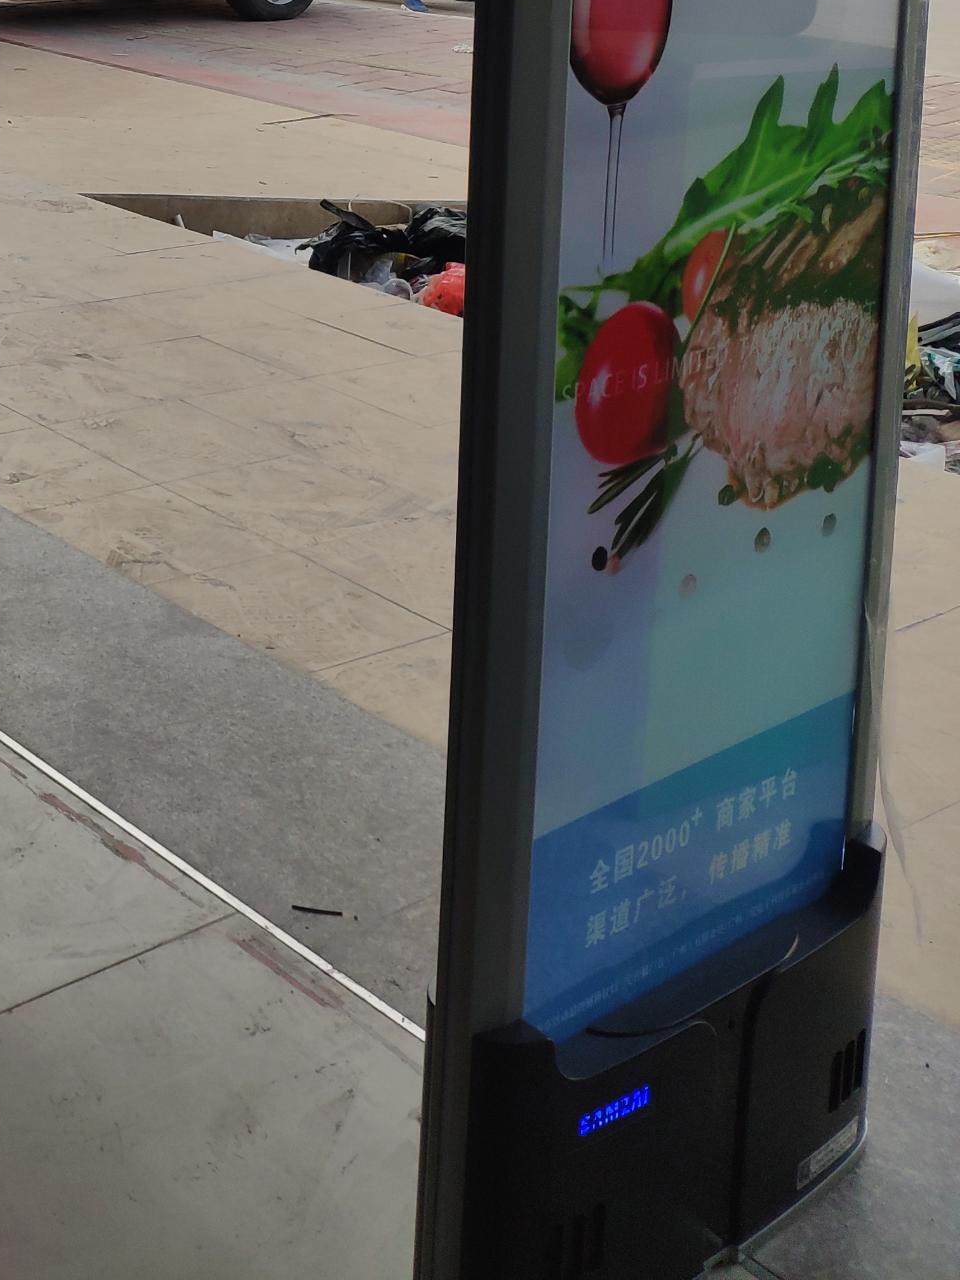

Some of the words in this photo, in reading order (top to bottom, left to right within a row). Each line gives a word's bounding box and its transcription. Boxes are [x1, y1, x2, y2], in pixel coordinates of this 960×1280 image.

[589, 807, 703, 895] 全国2000+
[716, 768, 799, 832] 商家平台
[708, 818, 792, 885] 传播精准
